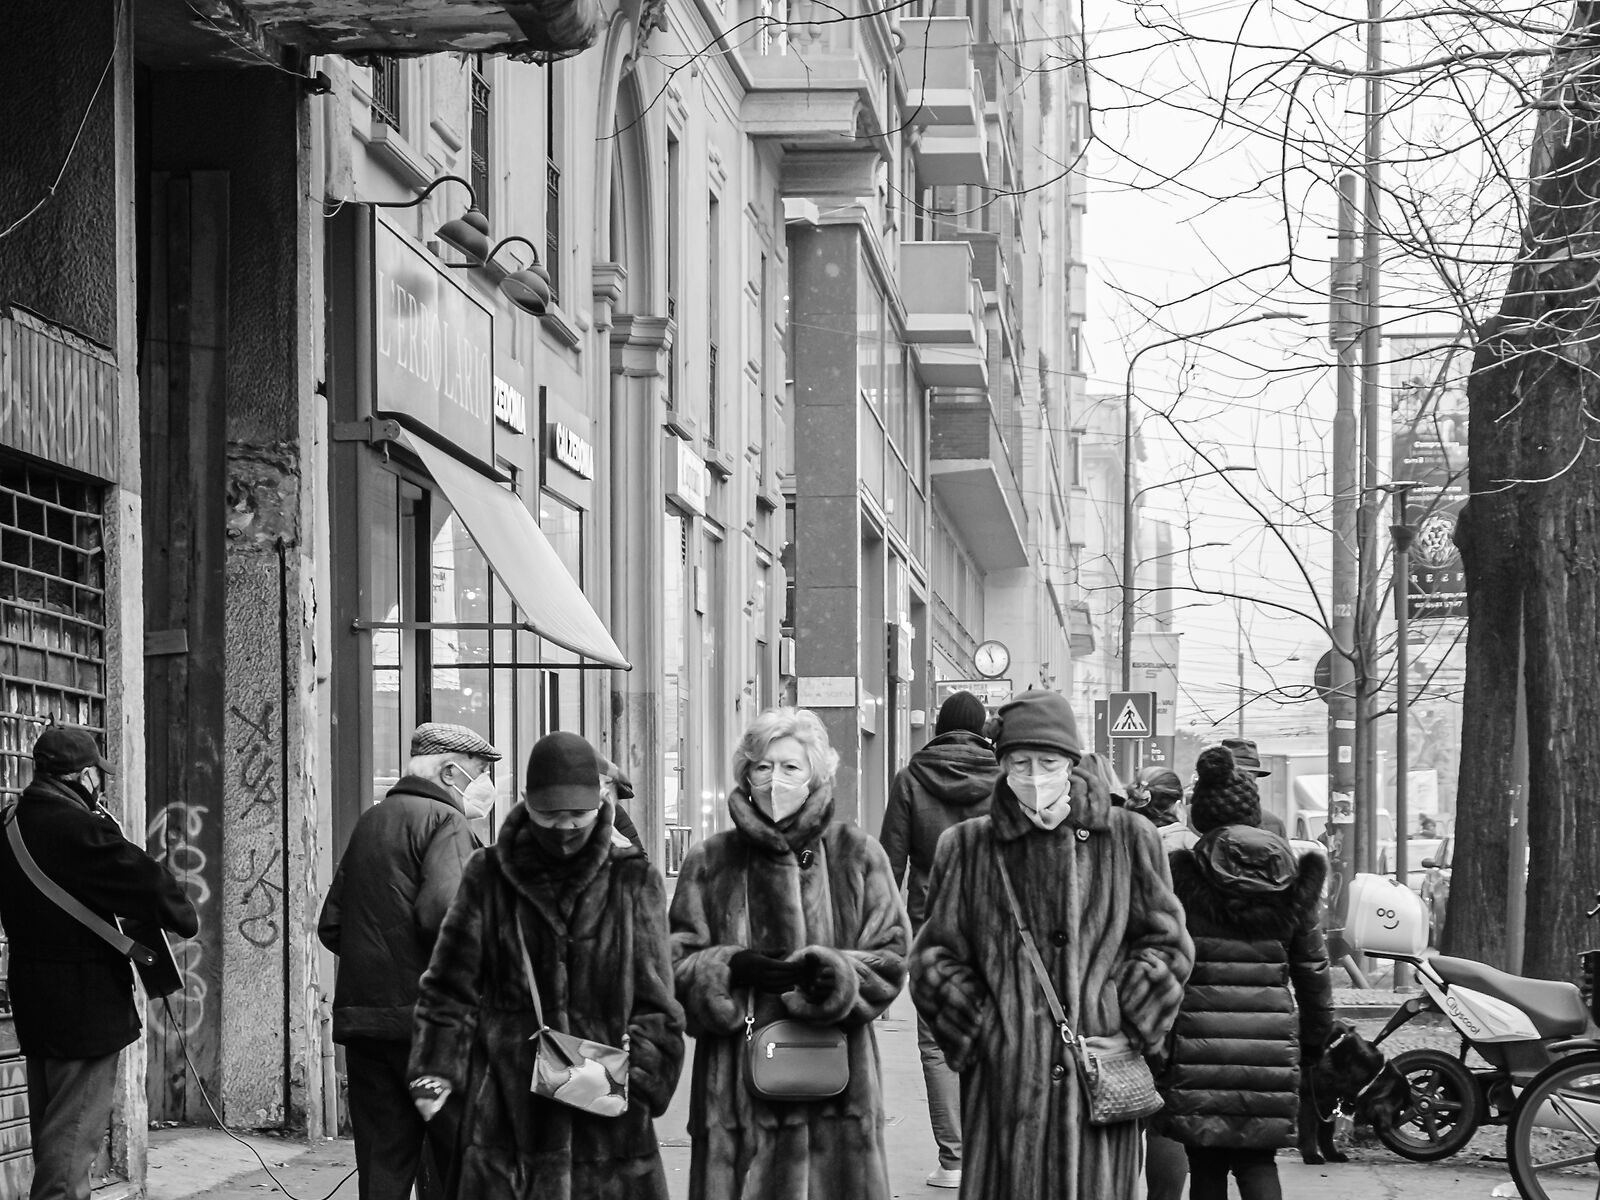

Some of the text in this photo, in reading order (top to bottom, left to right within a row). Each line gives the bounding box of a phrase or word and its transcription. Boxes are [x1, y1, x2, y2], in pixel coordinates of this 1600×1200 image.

[379, 271, 490, 425] L'ERBOLARIO
[556, 422, 594, 480] CALZEDONIA
[1411, 573, 1465, 583] REEF
[1446, 996, 1480, 1035] Cityscoot
